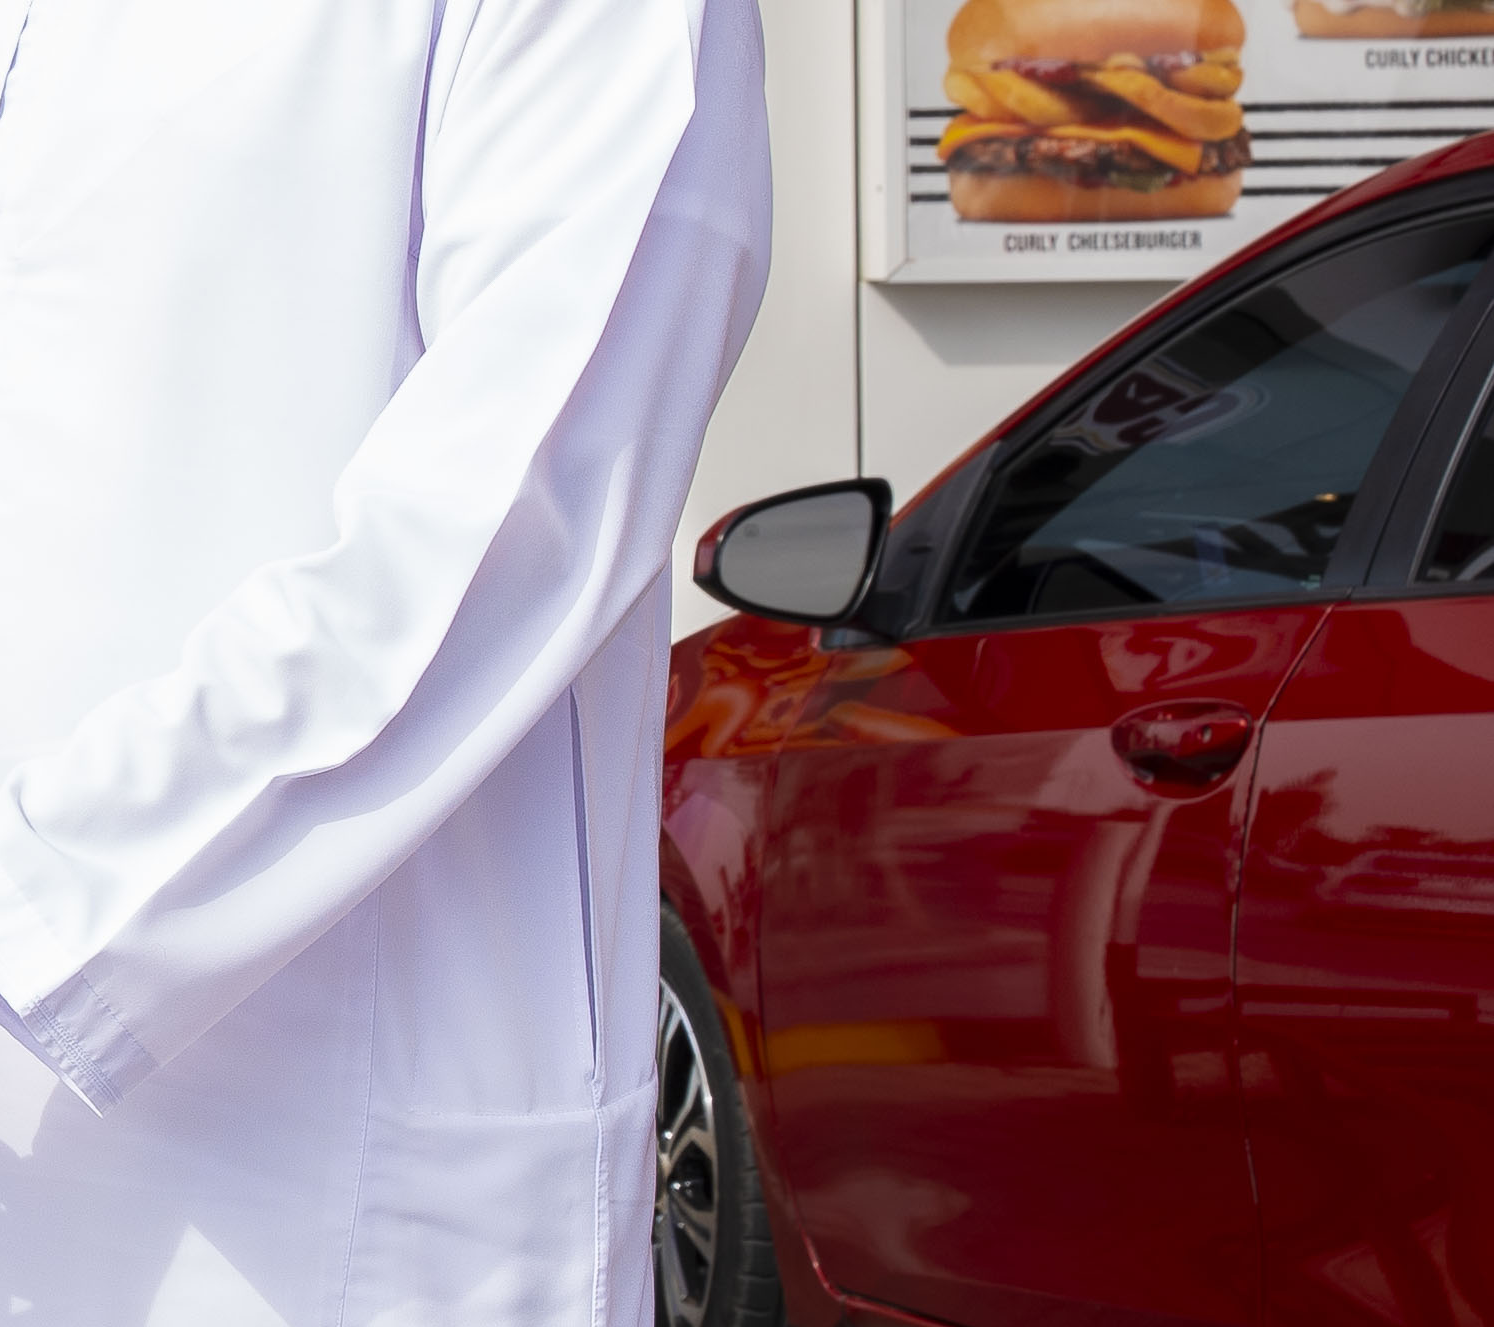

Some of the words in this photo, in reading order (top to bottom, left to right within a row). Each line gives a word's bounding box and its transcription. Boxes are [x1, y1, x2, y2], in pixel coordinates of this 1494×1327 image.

[1364, 48, 1419, 70] CURLY
[1426, 47, 1494, 68] CHICKE
[1004, 233, 1058, 252] CURLY
[1067, 230, 1203, 252] CHEESEBURGER
